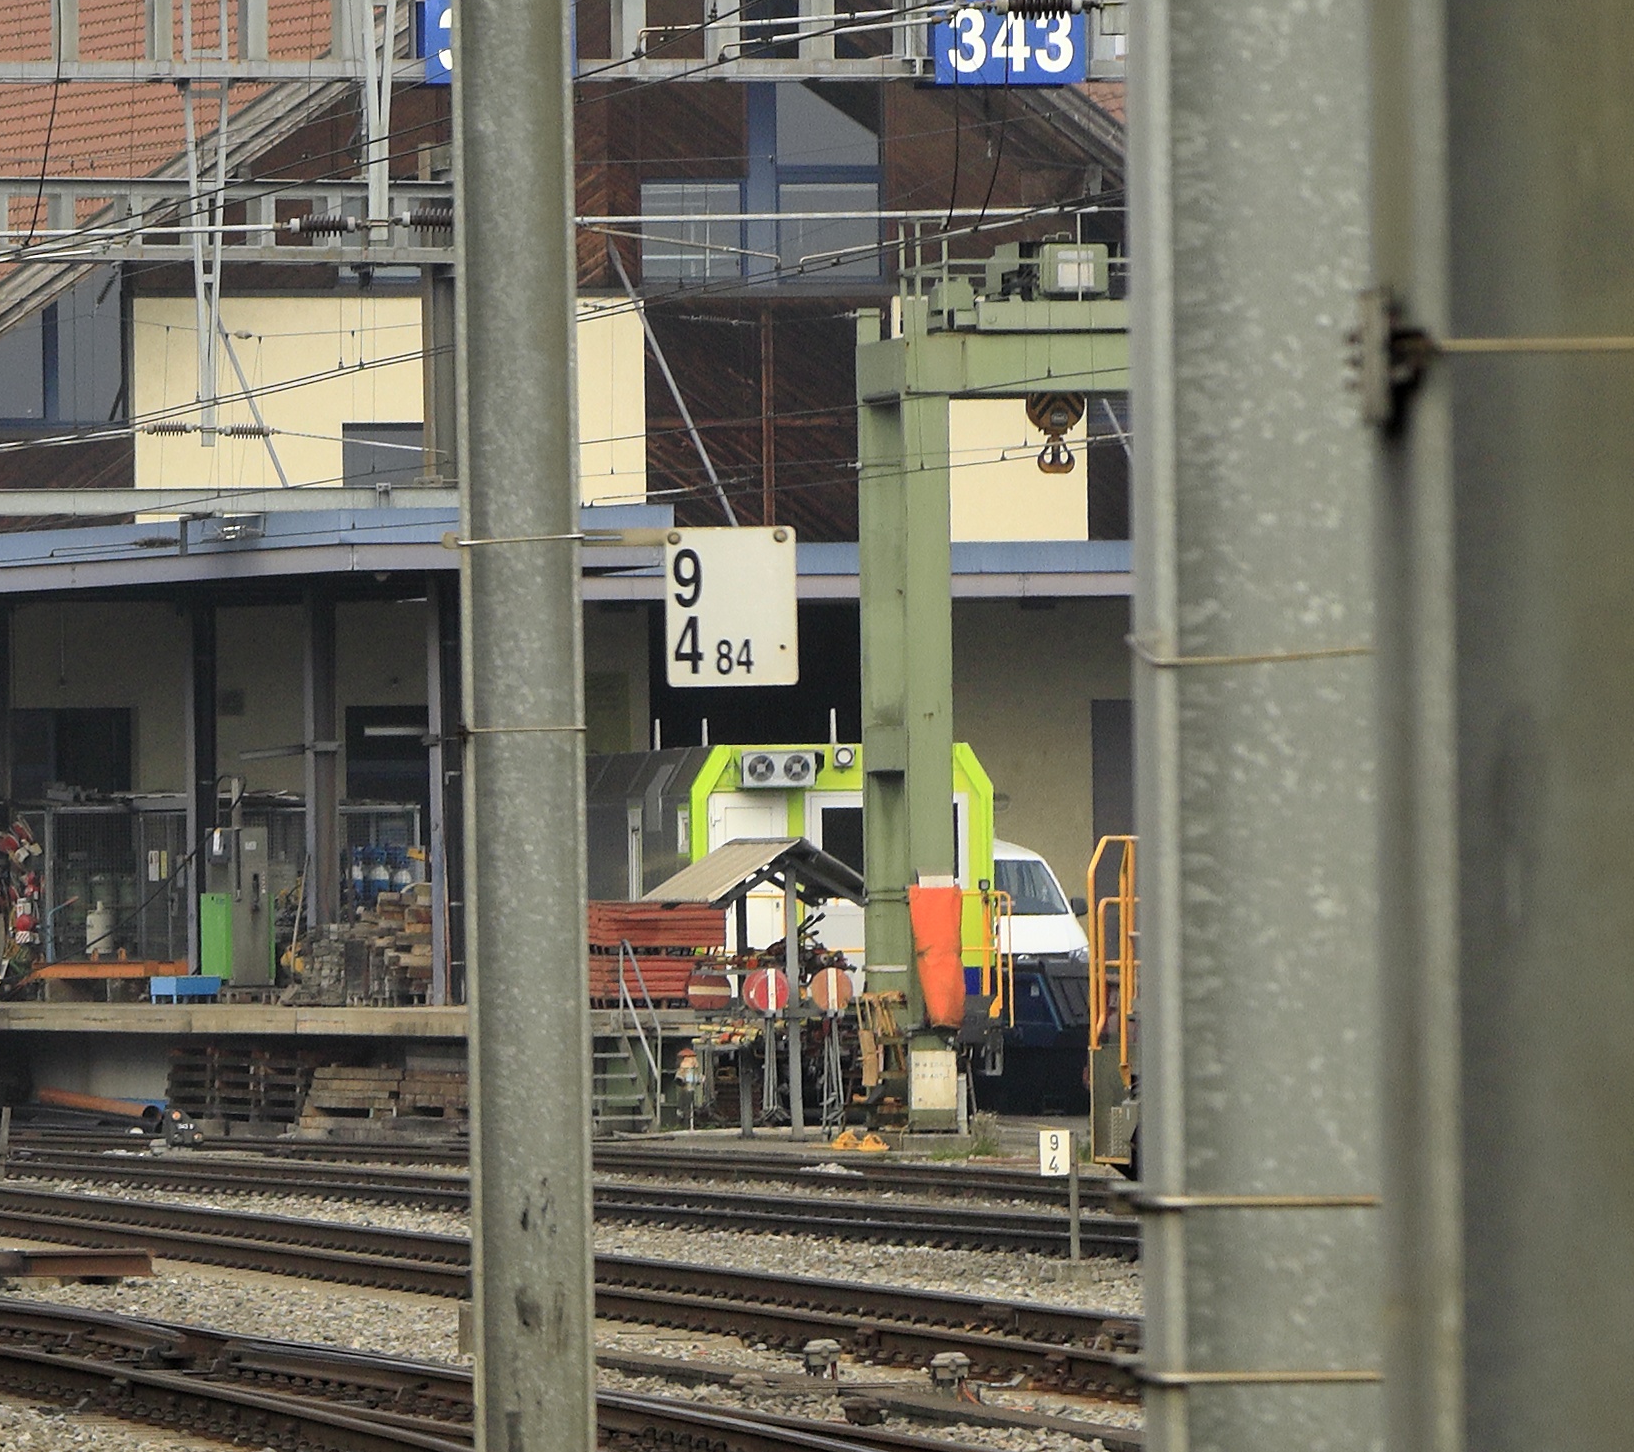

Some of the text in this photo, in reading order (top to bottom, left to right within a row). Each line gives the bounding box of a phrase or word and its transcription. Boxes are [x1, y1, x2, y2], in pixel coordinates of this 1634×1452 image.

[947, 5, 1075, 72] 343
[672, 548, 704, 608] 9
[673, 616, 755, 675] 4 84
[1048, 1155, 1060, 1174] 4
[1049, 1134, 1059, 1152] 9
